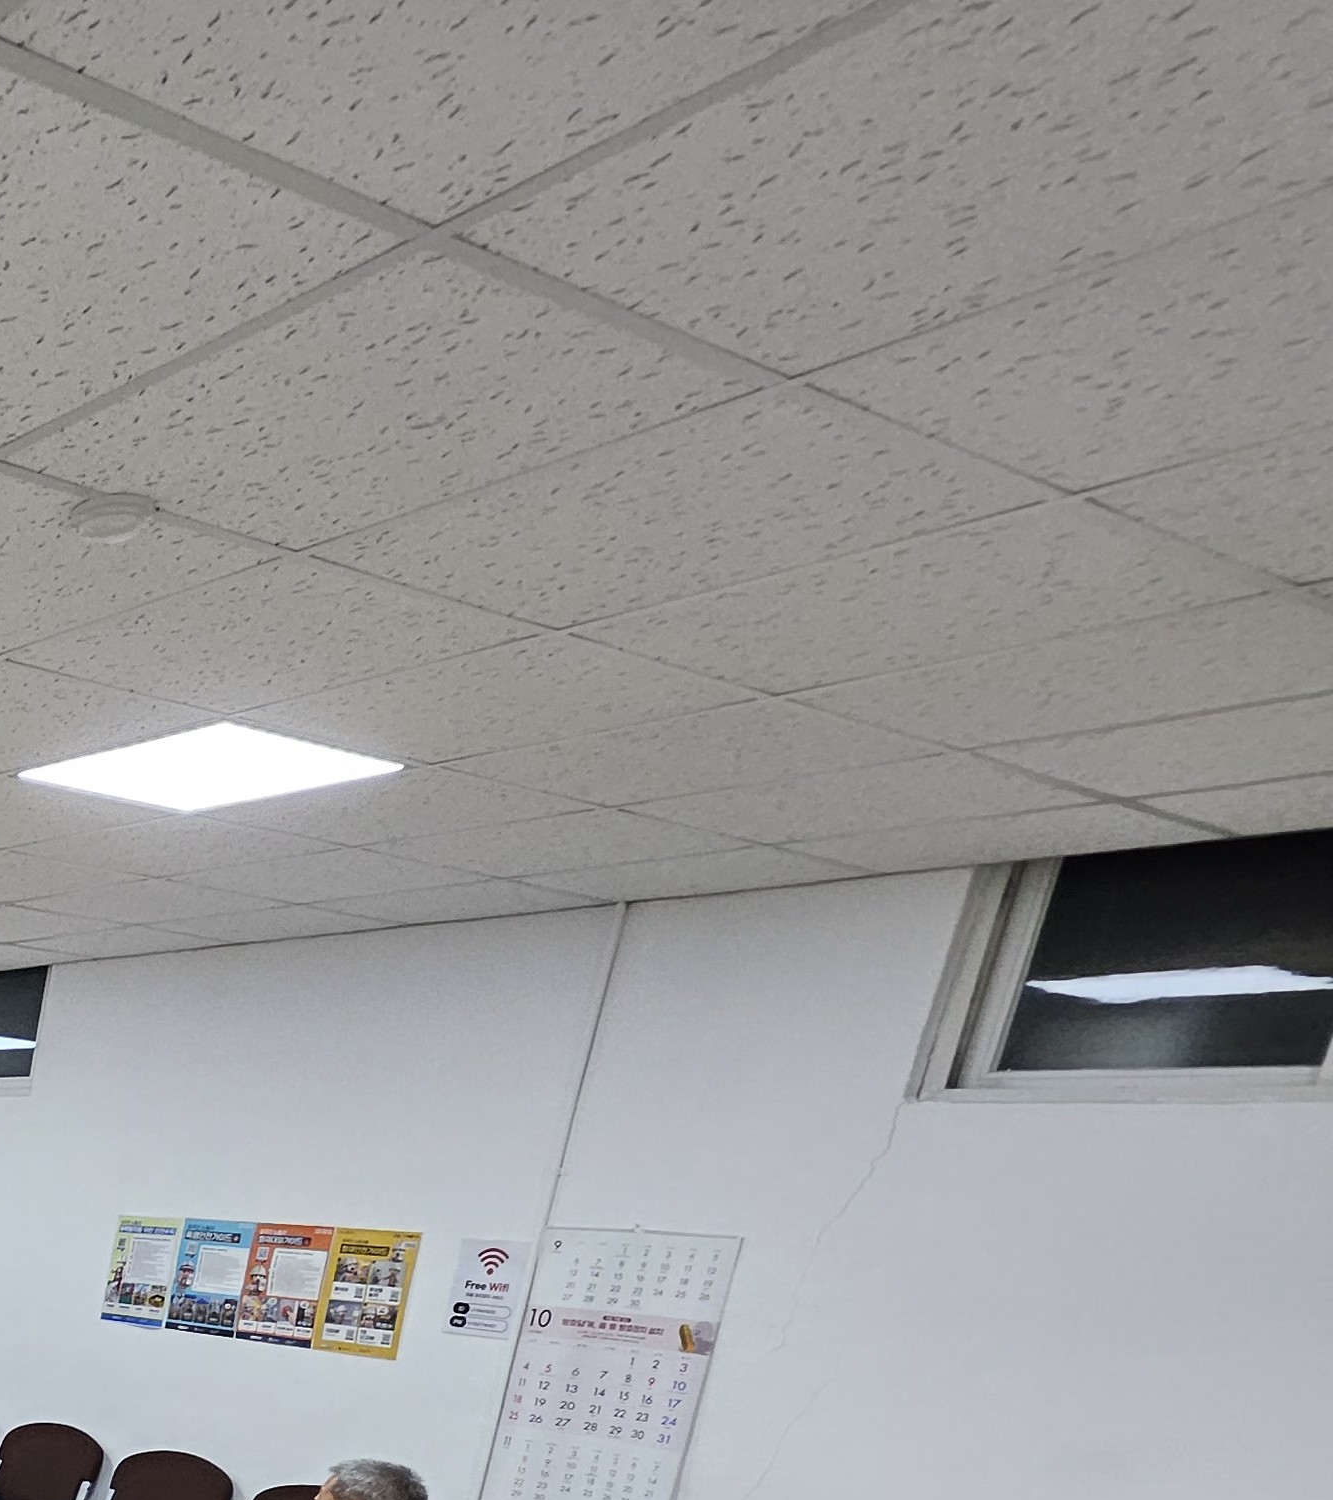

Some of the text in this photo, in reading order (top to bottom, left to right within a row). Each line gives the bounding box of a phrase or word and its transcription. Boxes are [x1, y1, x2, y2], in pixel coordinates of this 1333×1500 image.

[554, 1241, 562, 1249] 9
[465, 1280, 510, 1292] Free Wifi
[530, 1308, 552, 1328] 10
[545, 1364, 552, 1373] 5
[572, 1368, 580, 1376] 6
[600, 1371, 608, 1379] 7
[625, 1374, 631, 1383] 8
[648, 1377, 655, 1386] 9
[672, 1381, 686, 1390] 10
[652, 1360, 660, 1369] 2
[680, 1363, 688, 1372] 3
[519, 1378, 681, 1407] 11 12 13 14 15 16 17
[514, 1395, 677, 1426] 18 19 20 21 22 23 24
[509, 1412, 670, 1444] 25 26 27 28 29 30 31
